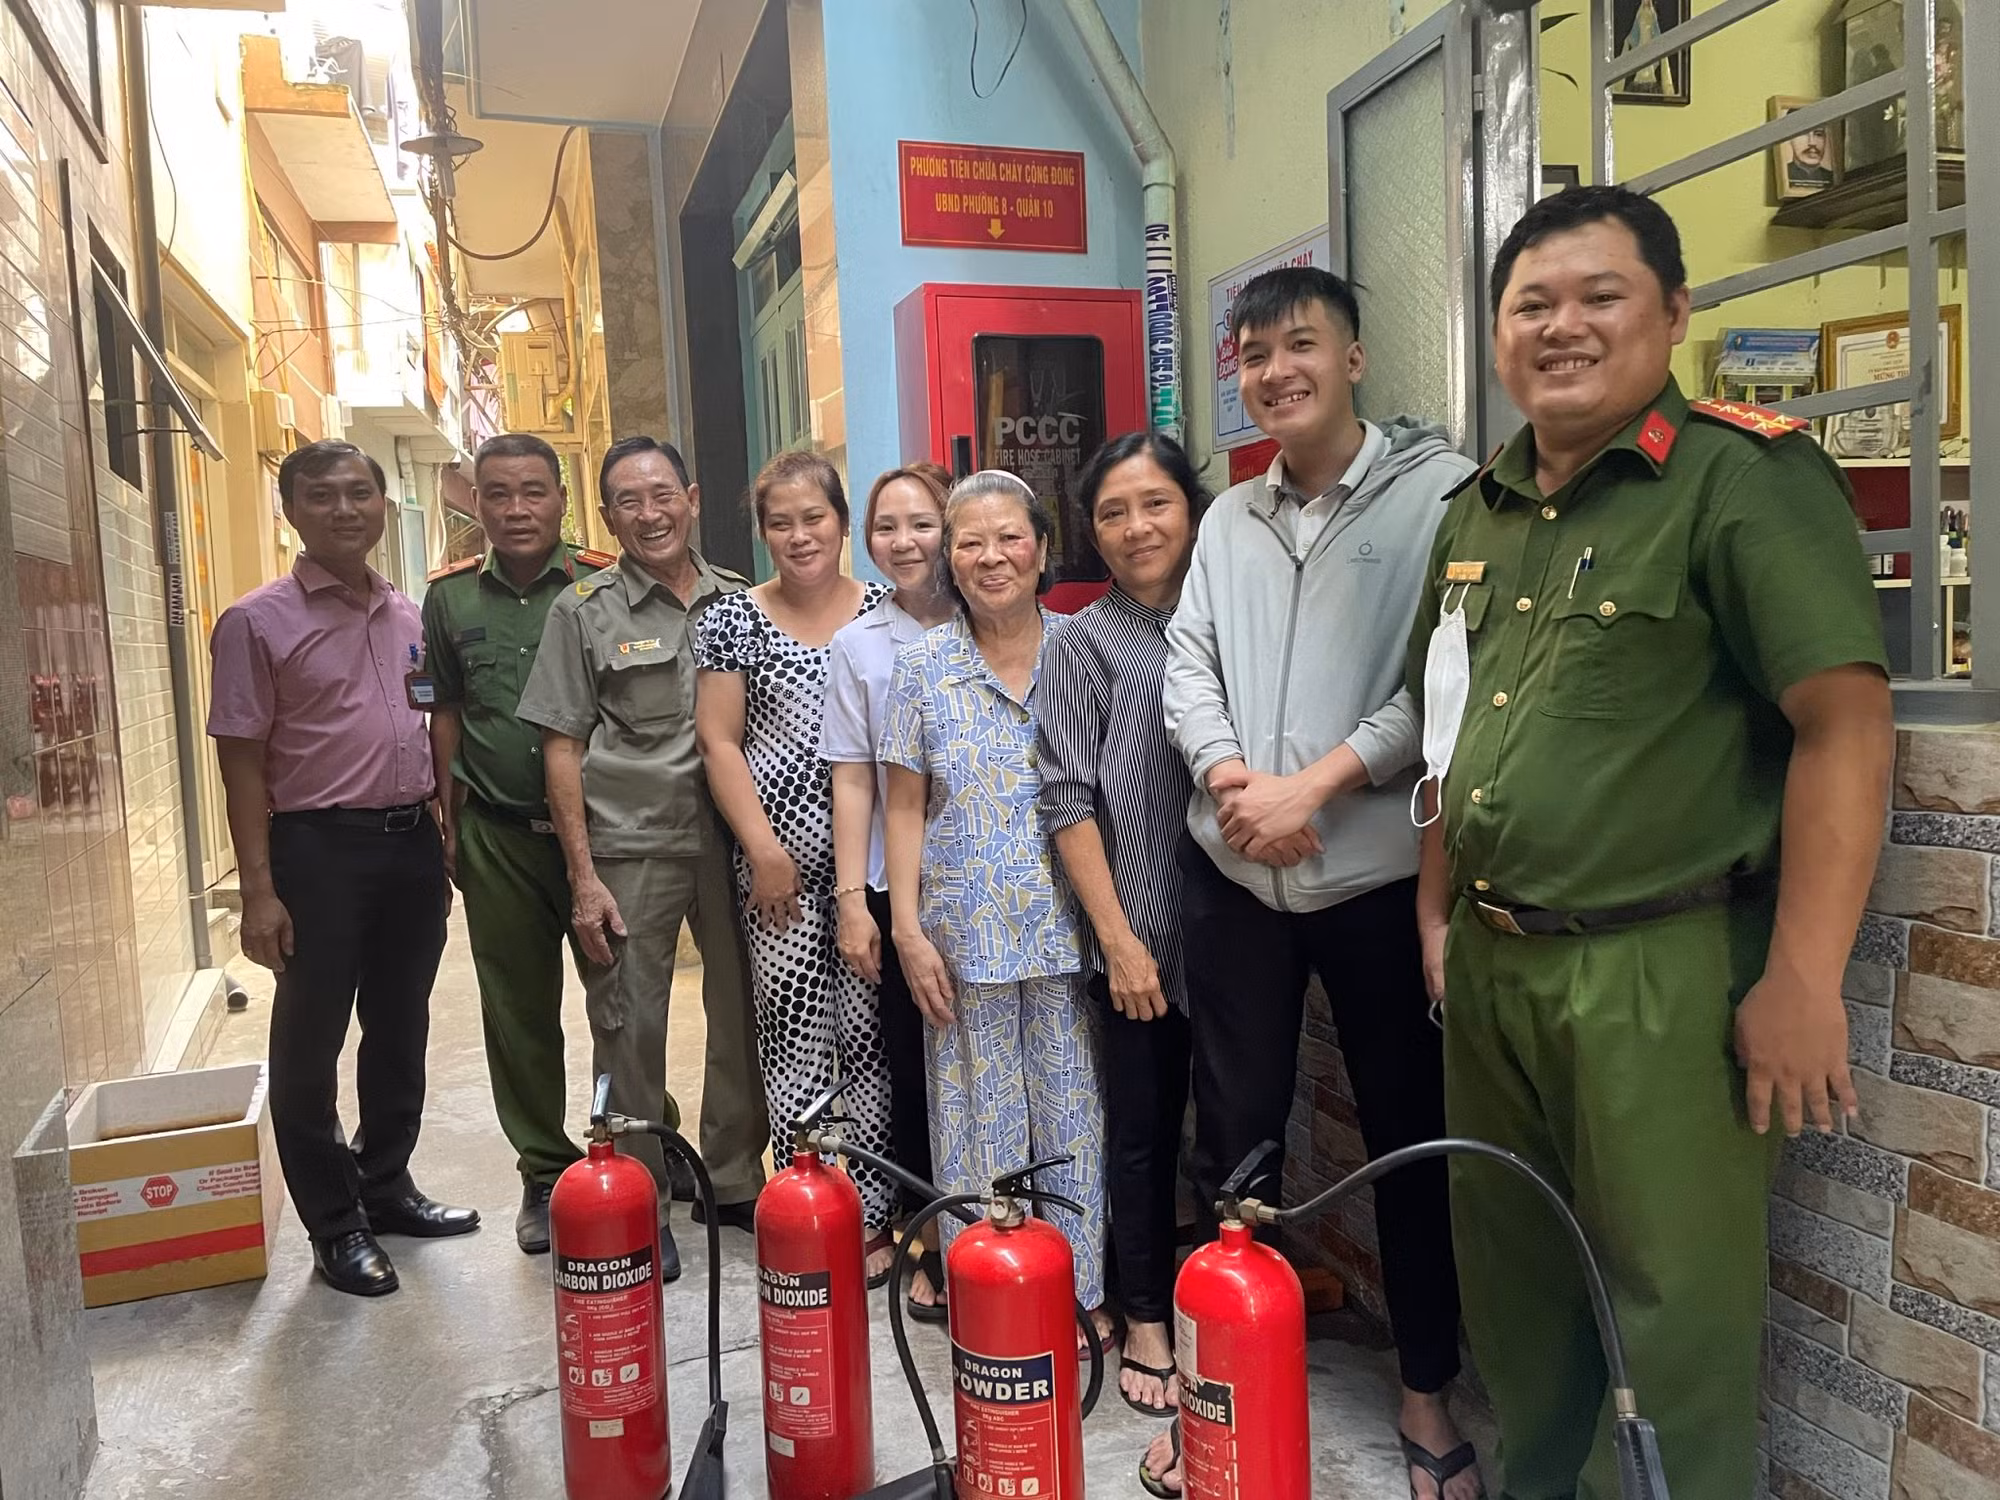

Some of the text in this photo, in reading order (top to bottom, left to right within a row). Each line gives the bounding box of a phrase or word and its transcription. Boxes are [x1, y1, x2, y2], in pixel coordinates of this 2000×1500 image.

[910, 155, 947, 178] PHƯƠNG
[950, 155, 970, 183] TIỆN
[972, 158, 997, 181] CHỮA
[999, 158, 1022, 183] CHÁY
[1024, 160, 1049, 188] CỘNG
[935, 192, 960, 213] UBND
[963, 190, 999, 215] PHƯỜNG
[1001, 198, 1007, 216] 8
[1016, 194, 1040, 221] QUẬN
[1043, 199, 1054, 218] 10
[993, 415, 1080, 446] PCCC
[994, 447, 1081, 467] FIRE HOSE CABINET
[146, 1185, 173, 1200] STOP
[567, 1257, 631, 1273] DRAGON
[602, 1261, 652, 1290] DIOXIDE
[773, 1287, 828, 1307] DIOXIDE
[964, 1359, 1022, 1378] DRAGON
[953, 1365, 1049, 1401] POWDER
